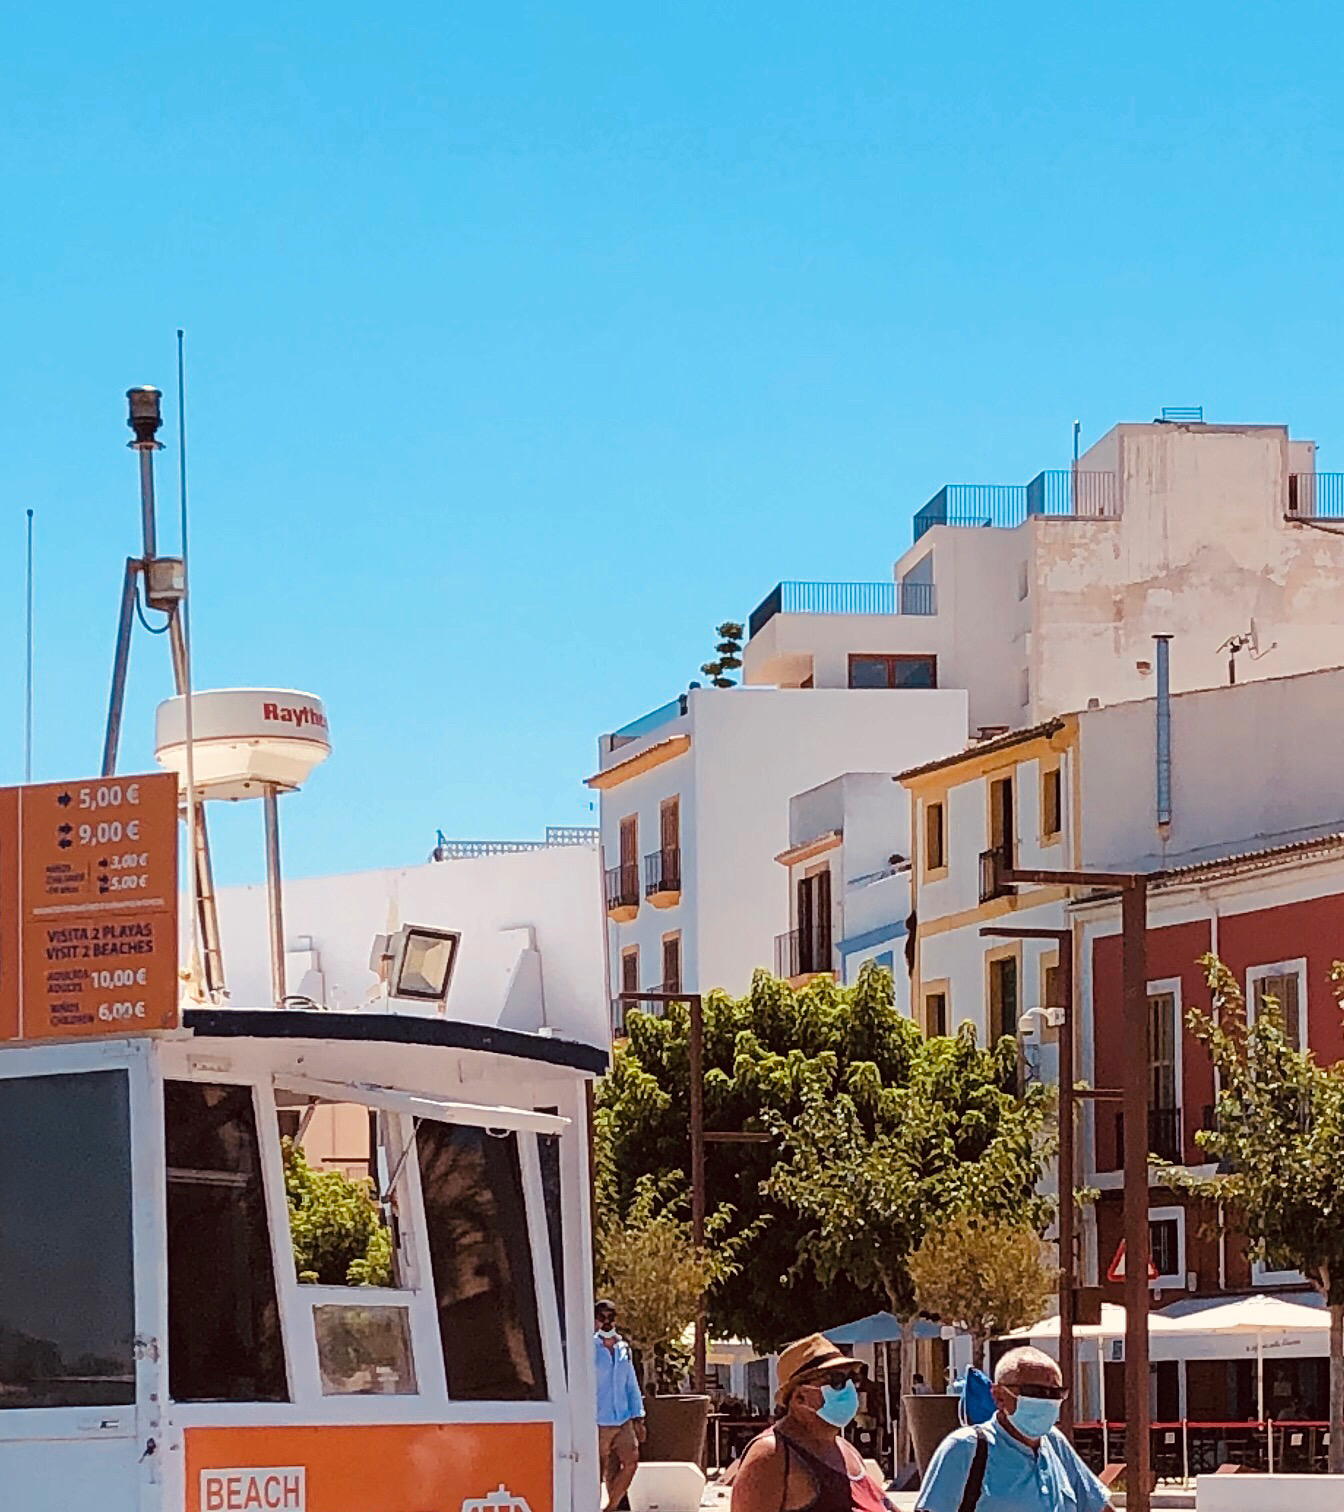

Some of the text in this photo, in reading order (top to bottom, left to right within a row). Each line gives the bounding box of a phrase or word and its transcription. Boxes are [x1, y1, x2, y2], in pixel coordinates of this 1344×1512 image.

[79, 785, 123, 811] 5,00
[79, 821, 123, 847] 9,00
[47, 922, 153, 943] VISITA 2 PLAYAS
[46, 939, 154, 960] VISIT 2 BEACHES
[205, 1474, 301, 1511] BEACH
